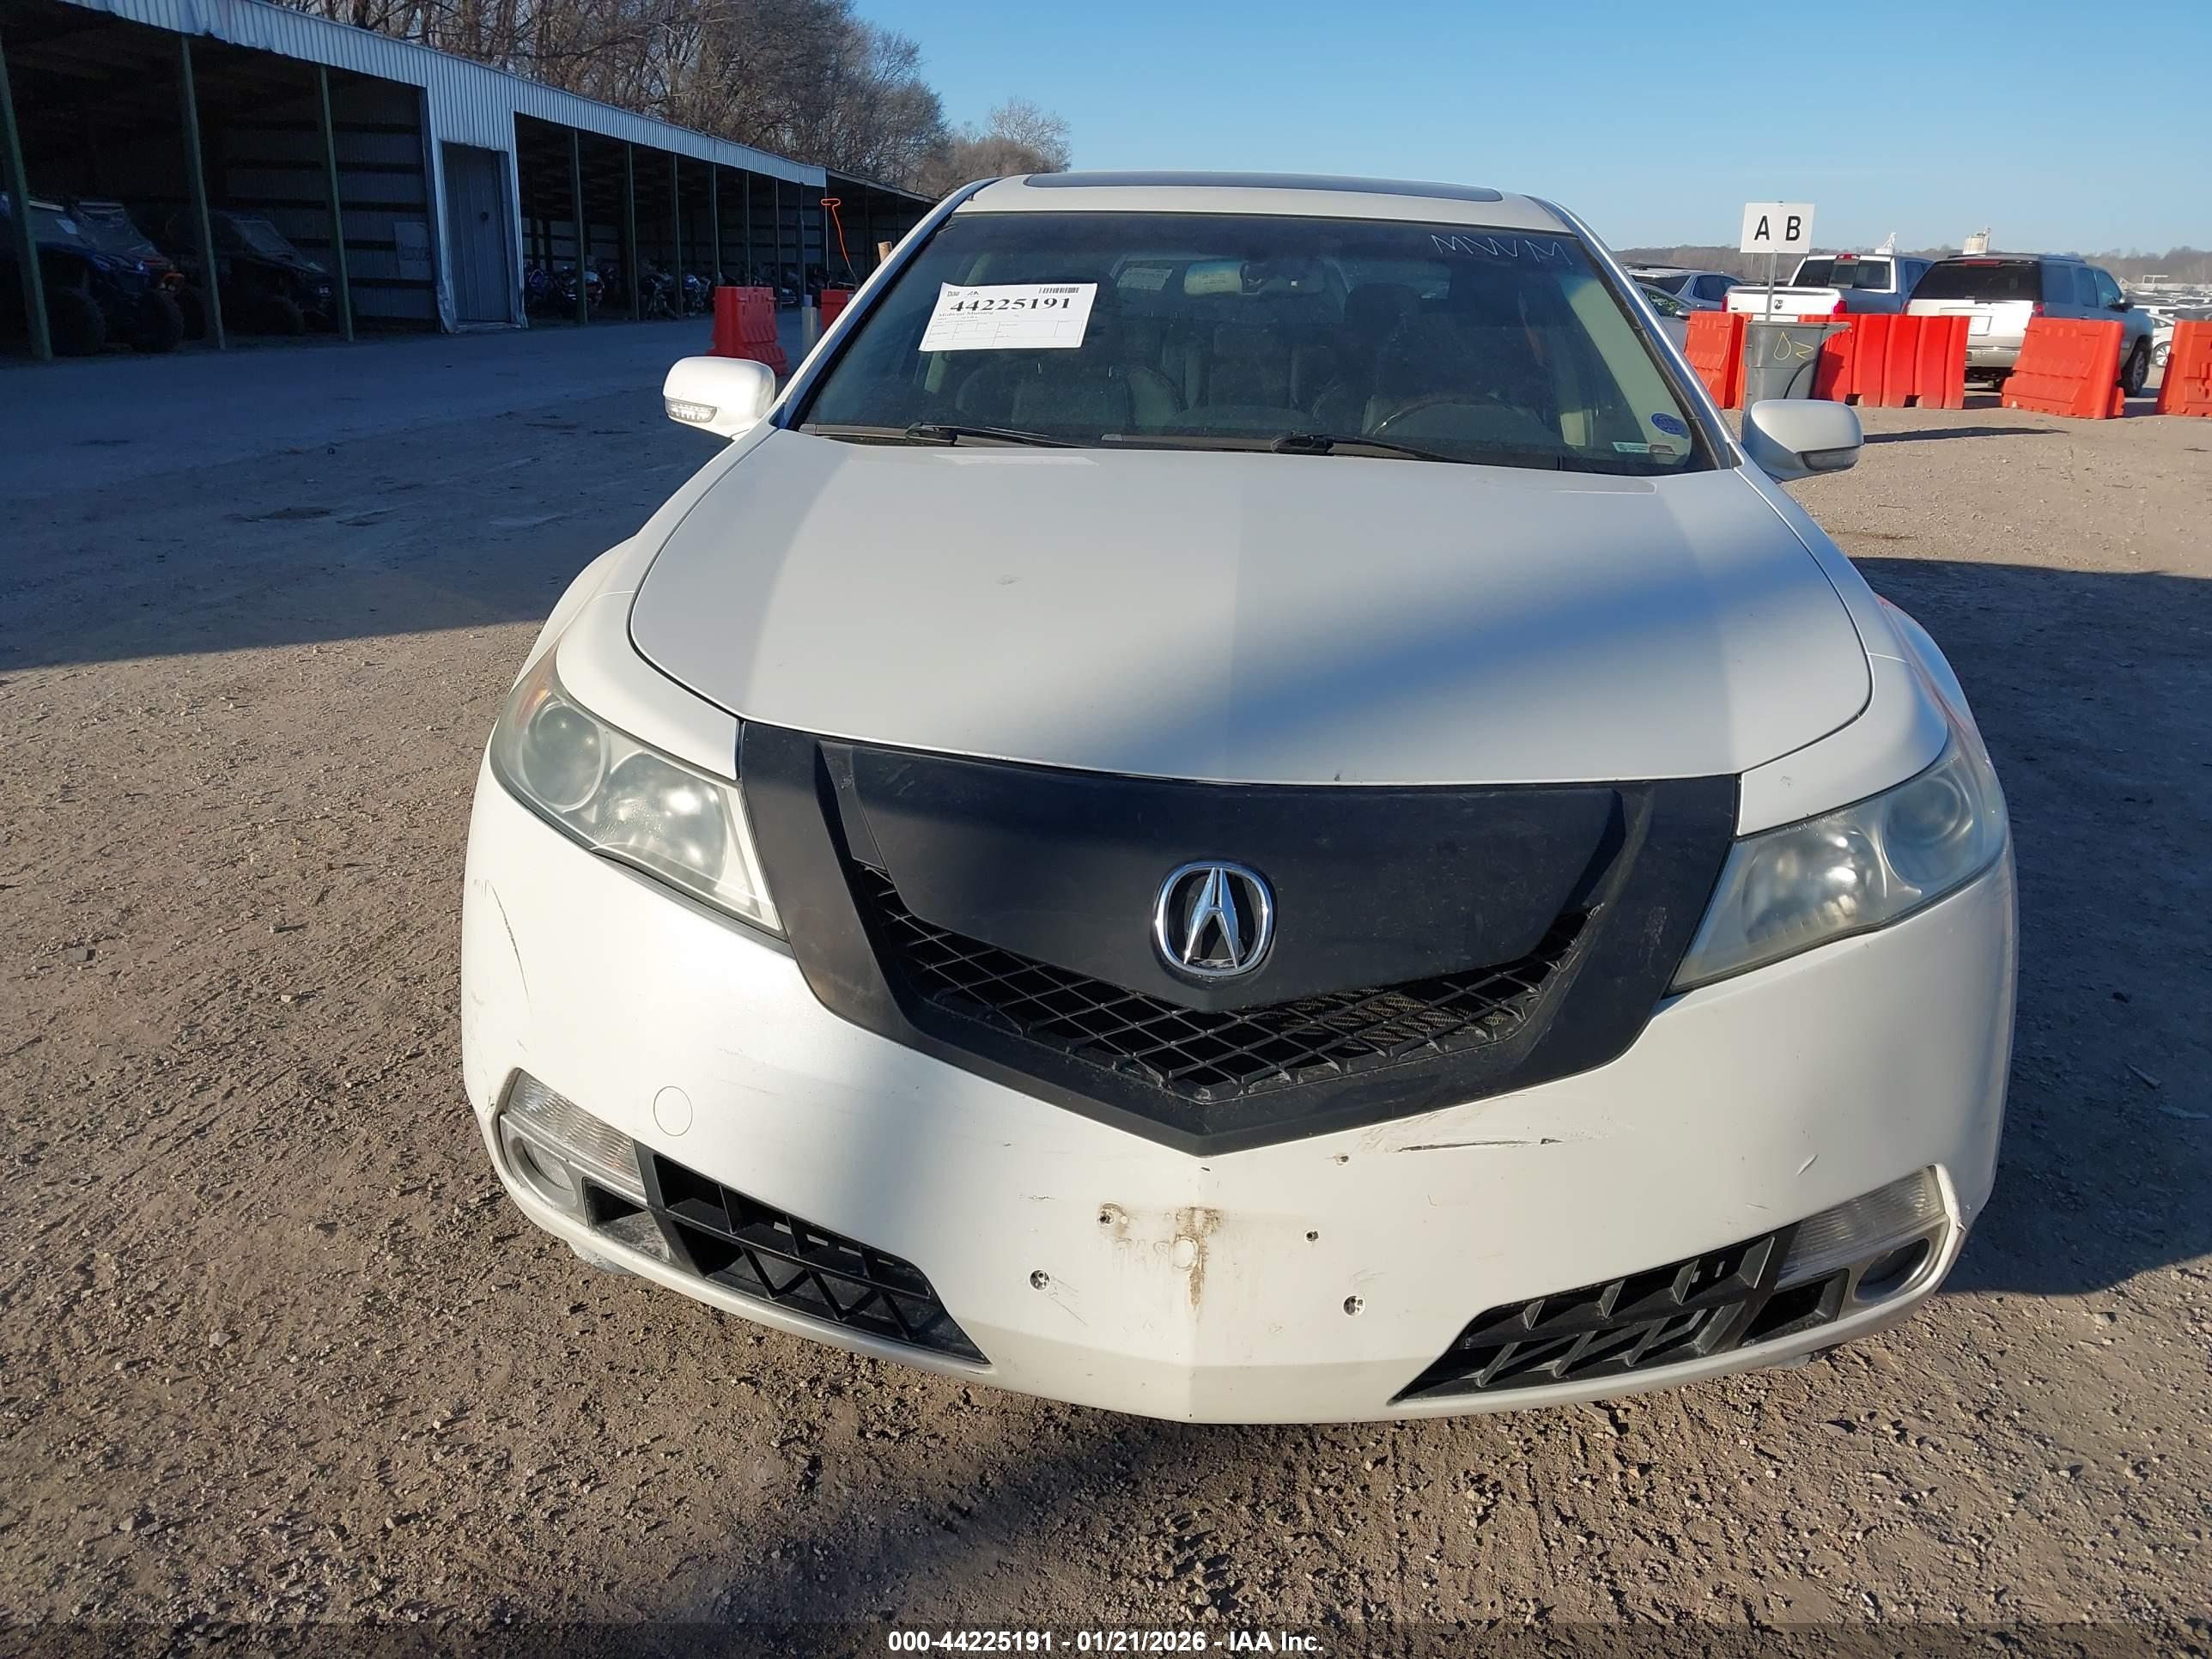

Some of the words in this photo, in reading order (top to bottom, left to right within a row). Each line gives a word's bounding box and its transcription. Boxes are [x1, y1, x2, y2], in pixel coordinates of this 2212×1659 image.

[1753, 215, 1771, 241] A
[1785, 215, 1802, 241] B
[949, 297, 1071, 312] 44225191
